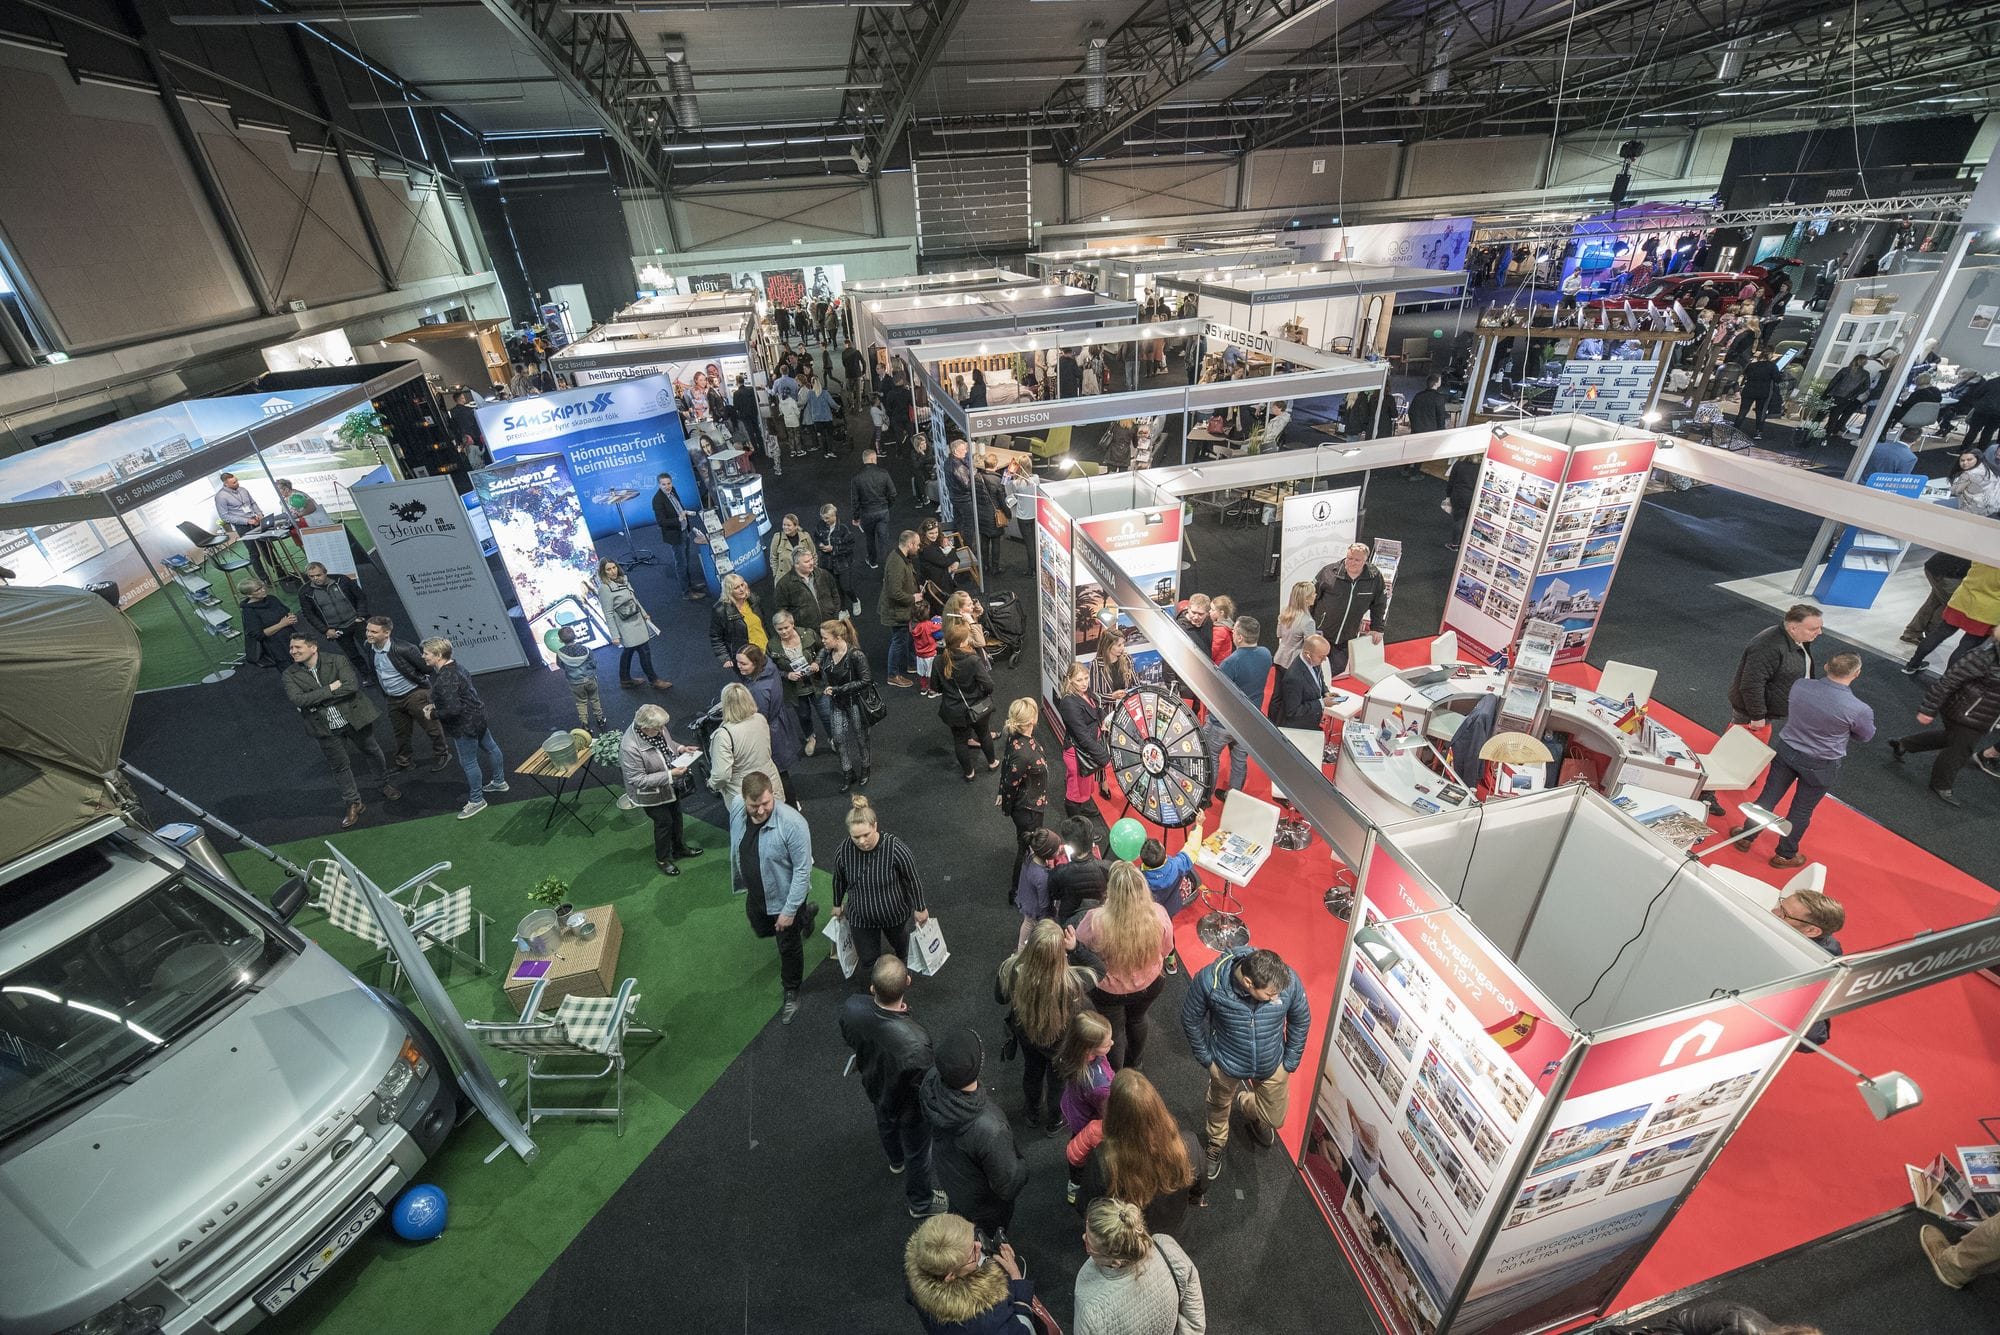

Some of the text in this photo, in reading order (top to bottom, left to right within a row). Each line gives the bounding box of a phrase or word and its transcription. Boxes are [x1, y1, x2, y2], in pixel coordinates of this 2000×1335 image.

[1826, 188, 1853, 197] PARKET
[1211, 325, 1272, 353] SYRUSSON
[976, 412, 1050, 428] B-3 SYRUSSON
[570, 432, 667, 463] Hönnunarforrit
[574, 451, 647, 476] heimilisins!
[116, 469, 185, 505] B-1 SPÁNAREIGNIR
[1076, 536, 1116, 589] EUROMARINA
[1452, 963, 1484, 1001] 1972
[151, 1107, 346, 1269] LAND ROVER
[280, 1263, 320, 1293] YK
[338, 1207, 377, 1249] 298
